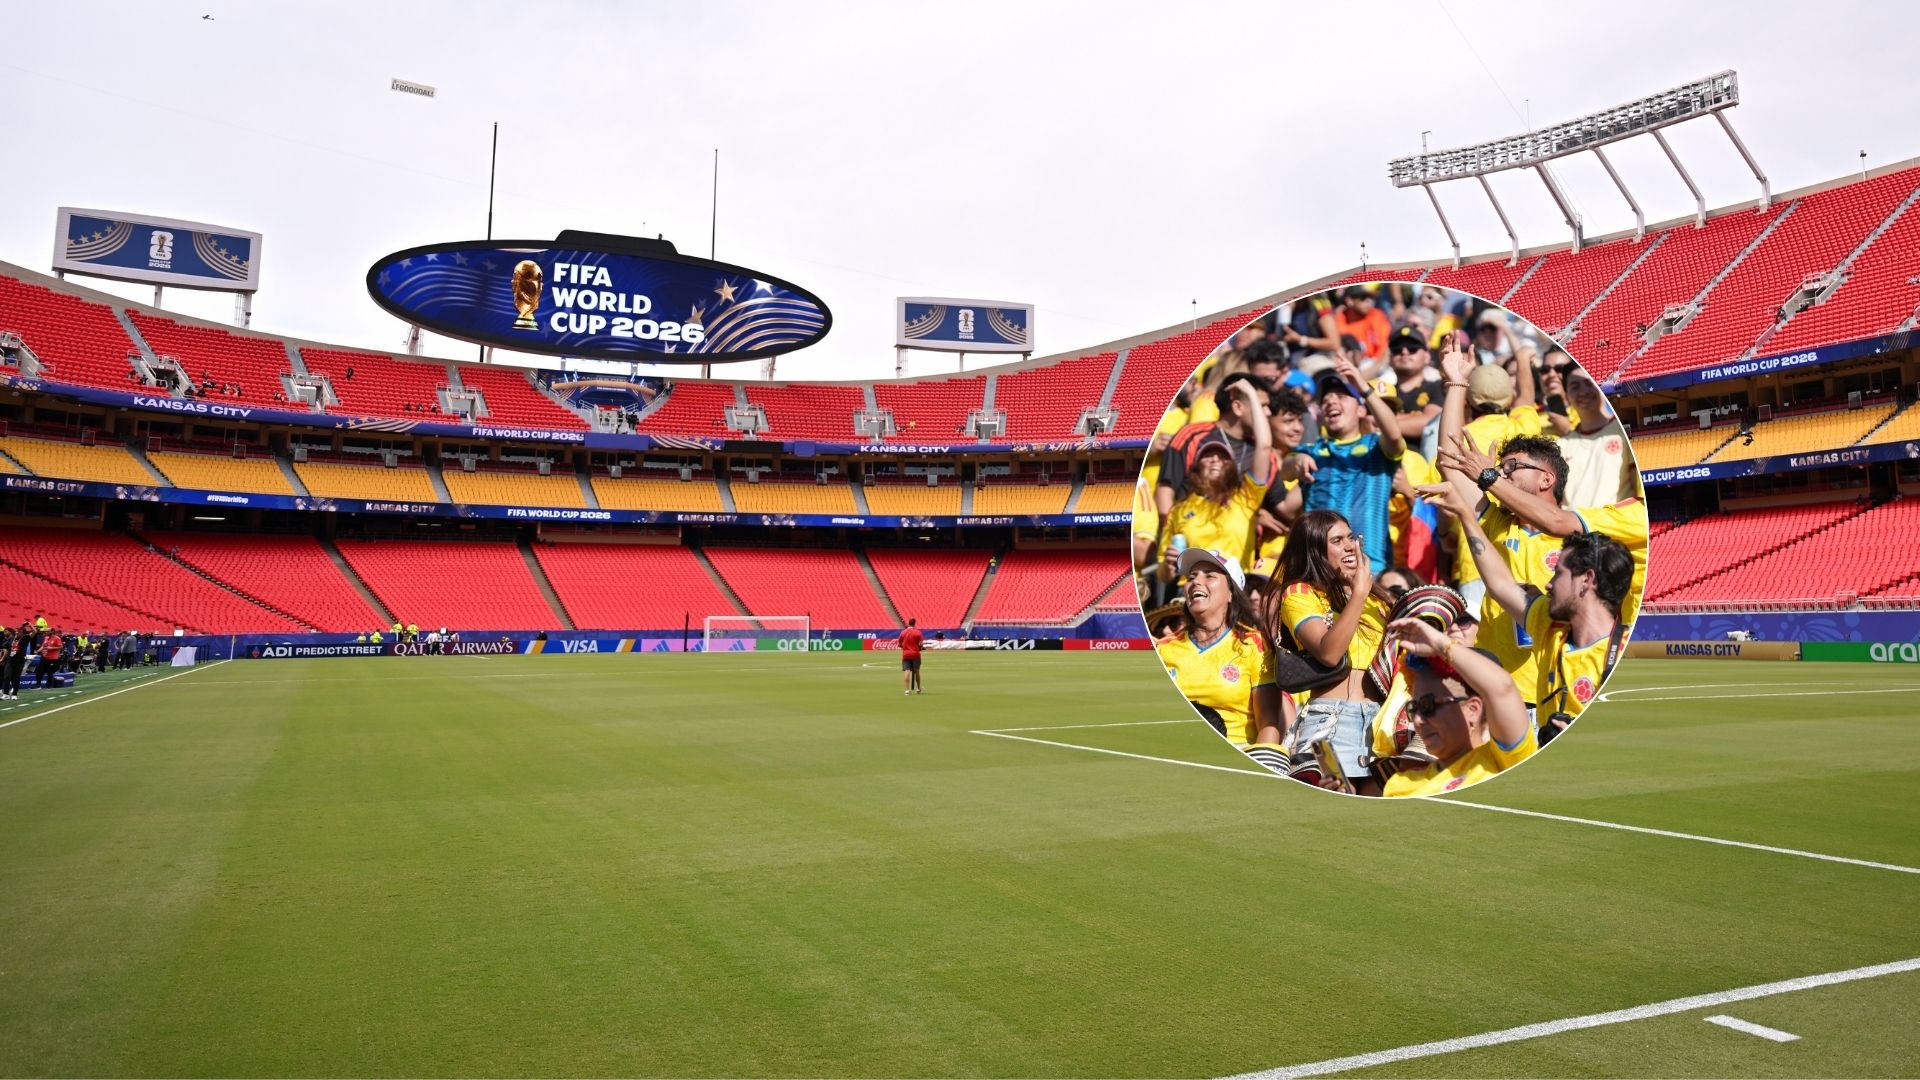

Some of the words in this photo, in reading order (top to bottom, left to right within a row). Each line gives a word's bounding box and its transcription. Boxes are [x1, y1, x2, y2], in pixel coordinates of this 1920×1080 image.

[553, 262, 613, 287] FIFA
[551, 286, 652, 315] WORLD
[550, 311, 607, 335] CUP
[611, 317, 705, 344] 2026
[1701, 370, 1722, 380] FIFA
[1722, 362, 1759, 376] WORLD
[1759, 358, 1780, 369] CUP
[1780, 352, 1817, 367] 2026
[133, 396, 208, 413] KANSAS
[211, 405, 252, 417] CITY
[472, 427, 493, 436] FIFA
[494, 429, 530, 438] WORLD
[531, 431, 551, 439] CUP
[551, 432, 585, 441] 2026
[860, 445, 917, 453] KANSAS
[1790, 453, 1839, 467] KANSAS
[1841, 449, 1870, 462] CITY
[1655, 471, 1676, 482] CUP
[1676, 467, 1711, 480] 2026
[6, 477, 55, 490] KANSAS
[56, 482, 85, 492] CITY
[365, 502, 409, 512] KANSAS
[411, 504, 436, 513] CITY
[507, 508, 528, 517] FIFA
[528, 509, 561, 518] WORLD
[561, 510, 579, 519] CUP
[579, 511, 611, 520] 2026
[677, 513, 715, 522] KANSAS
[716, 514, 738, 522] CITY
[956, 517, 992, 525] KANSAS
[993, 517, 1014, 525] CITY
[1074, 515, 1092, 524] FIFA
[1092, 514, 1120, 523] WORLD
[1121, 514, 1132, 522] CU
[262, 646, 293, 657] ADI
[295, 645, 383, 656] PREDICTSTREET
[394, 642, 446, 656] QATR
[451, 641, 514, 654] AIRWAYS
[560, 639, 599, 653] VISA
[777, 638, 843, 651] aramco
[1089, 639, 1130, 650] Lenovo
[1666, 643, 1712, 656] KANSAS
[1714, 643, 1742, 656] CITY
[1869, 642, 1920, 662] ara
